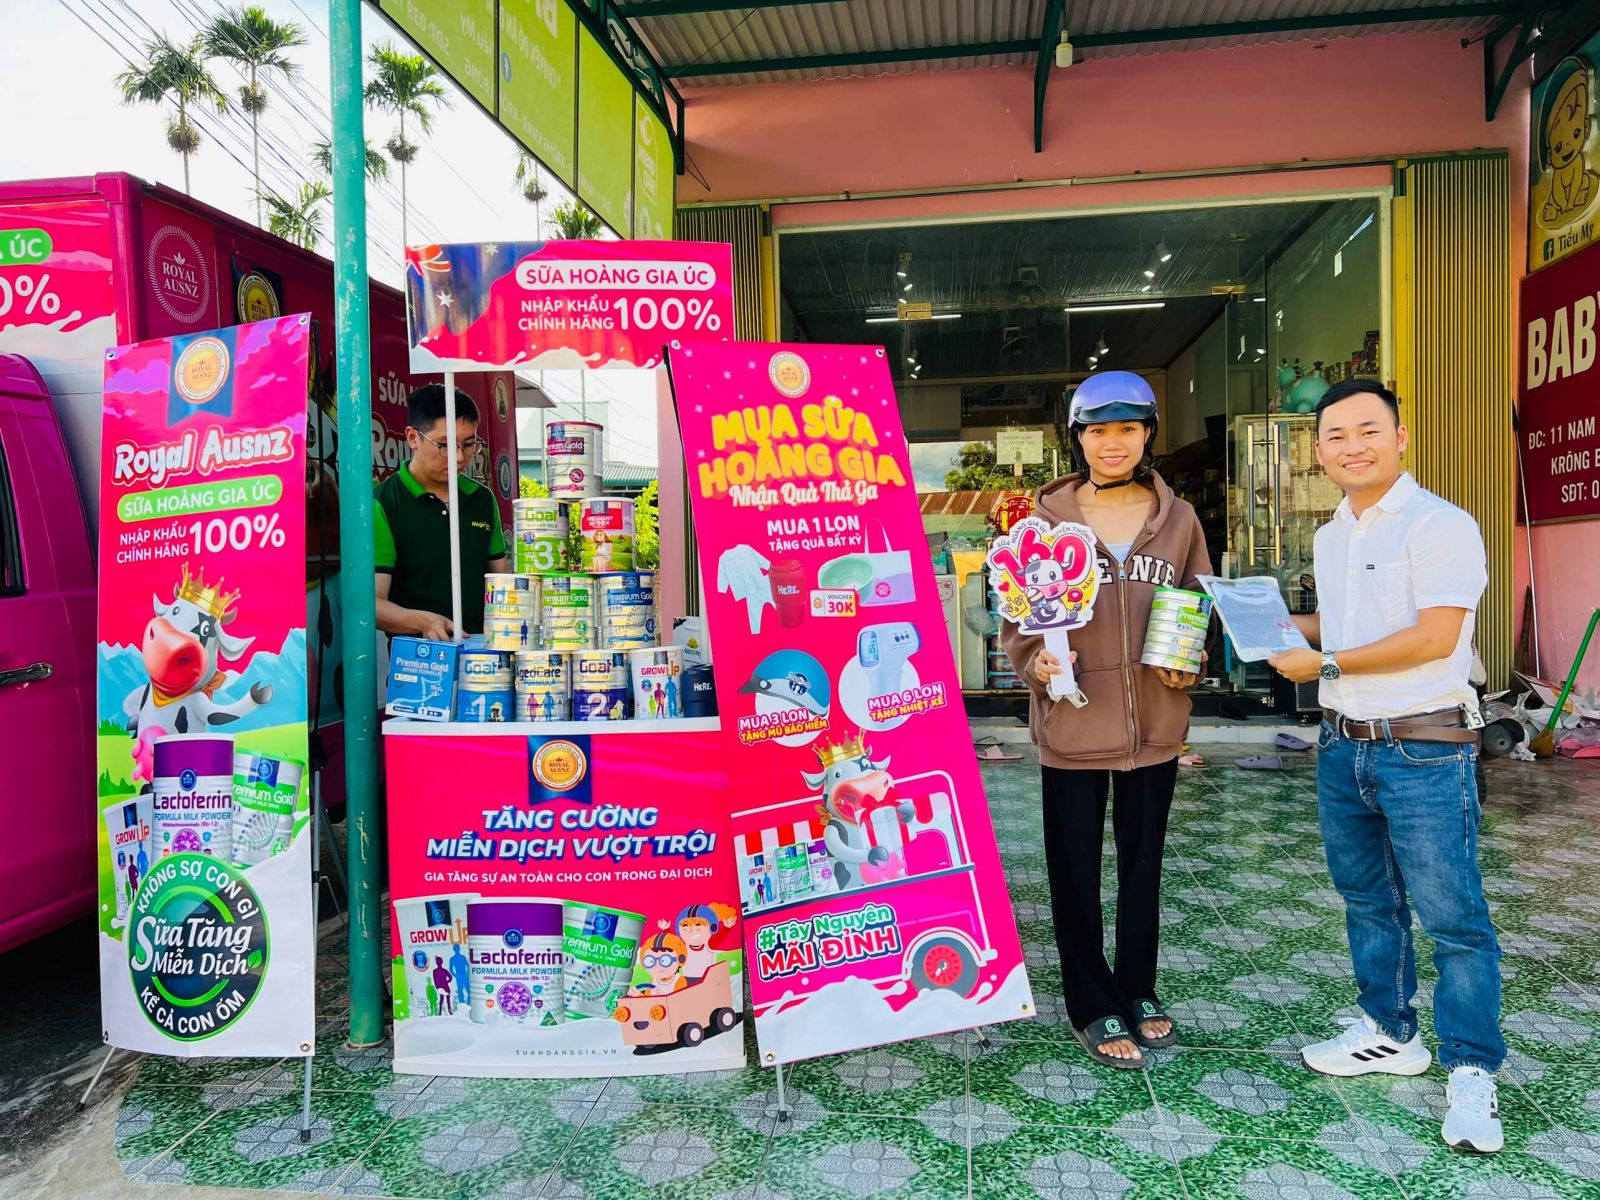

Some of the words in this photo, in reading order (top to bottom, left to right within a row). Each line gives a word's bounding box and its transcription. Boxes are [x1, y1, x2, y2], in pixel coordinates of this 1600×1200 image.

[10, 233, 42, 258] ÚC
[162, 261, 198, 284] ROYAL
[525, 264, 563, 284] SỮA
[569, 264, 640, 284] HOÀNG
[646, 269, 678, 284] GIA
[684, 266, 708, 285] ÚC
[163, 278, 199, 298] AUSNZ
[518, 315, 566, 331] CHÍNH
[569, 314, 614, 330] HÃNG
[613, 297, 721, 332] 100%
[521, 296, 563, 315] NHẬP
[567, 294, 609, 312] KHẨU
[1527, 291, 1600, 390] BAB
[711, 404, 799, 450] MUA
[801, 396, 879, 447] SỮA
[1528, 430, 1546, 450] ĐC:
[1550, 425, 1562, 445] 11
[1567, 416, 1596, 441] NAM
[114, 434, 193, 484] Royal
[200, 430, 288, 468] Ausnz
[565, 441, 583, 449] Gold
[699, 440, 833, 498] HOÀNG
[838, 446, 906, 486] GIA
[1551, 450, 1590, 476] KRÔNG
[124, 494, 153, 518] SỮA
[156, 490, 214, 513] HOÀNG
[218, 486, 248, 505] GIA
[252, 480, 275, 501] ÚC
[729, 484, 779, 511] Nhận
[781, 481, 819, 506] Quà
[820, 480, 853, 502] Thả
[854, 480, 878, 505] Ga
[1561, 482, 1587, 503] SĐT:
[116, 545, 151, 564] CHÍNH
[154, 542, 190, 559] HÃNG
[189, 512, 286, 555] 100%
[119, 527, 150, 547] NHẬP
[153, 521, 187, 542] KHẨU
[767, 518, 810, 536] MUA
[812, 517, 821, 534] 1
[825, 514, 860, 532] LON
[996, 537, 1011, 548] SỮA
[1010, 521, 1027, 544] HOÀNG
[1027, 519, 1040, 528] GIA
[1039, 523, 1048, 535] ÚC
[1048, 524, 1071, 543] TRUYỀN
[1072, 525, 1093, 543] THỐNG
[533, 541, 554, 570] 3
[768, 539, 800, 554] TẶNG
[801, 535, 825, 550] QUÀ
[827, 532, 847, 547] BẤT
[848, 533, 862, 546] KỲ
[991, 527, 1087, 588] 160
[1082, 575, 1095, 591] NĂM
[570, 593, 588, 602] Gold
[827, 601, 853, 613] 30K
[396, 657, 429, 669] Premium
[430, 661, 449, 672] Gold
[464, 660, 498, 675] Goat
[580, 659, 612, 674] Goat
[471, 694, 486, 722] 1
[587, 693, 608, 722] 2
[868, 693, 900, 710] MUA
[902, 691, 911, 702] 6
[913, 683, 944, 700] LON
[870, 708, 899, 723] TẶNG
[900, 700, 931, 716] NHIỆT
[931, 694, 945, 707] KẾ
[739, 713, 771, 731] MUA
[771, 712, 780, 726] 3
[781, 708, 809, 725] LON
[741, 730, 767, 744] TẶNG
[768, 725, 783, 737] MŨ
[784, 722, 804, 735] BẢO
[805, 716, 828, 730] HIỂM
[153, 789, 232, 810] Lactoferrin
[273, 787, 295, 806] Gold
[154, 812, 182, 821] FORMULA
[183, 812, 199, 821] MILK
[201, 811, 232, 820] POWDER
[481, 806, 554, 829] TĂNG
[560, 804, 658, 828] CƯỜNG
[426, 830, 492, 857] MIỄN
[498, 837, 564, 863] DỊCH
[572, 835, 651, 861] VƯỢT
[652, 829, 716, 856] TRỘI
[424, 871, 445, 882] GIA
[447, 869, 478, 883] TĂNG
[481, 870, 499, 886] SỰ
[500, 872, 517, 883] AN
[520, 870, 553, 883] TOÀN
[556, 872, 582, 883] CHO
[585, 871, 611, 882] CON
[614, 870, 656, 881] TRONG
[659, 869, 681, 881] ĐẠI
[683, 867, 713, 880] DỊCH
[137, 863, 177, 914] KHÔNG
[180, 860, 204, 880] SỢ
[205, 866, 242, 900] CON
[236, 898, 260, 920] GÌ
[759, 921, 812, 950] #Tây
[814, 905, 891, 933] Nguyên
[131, 916, 184, 971] Sữa
[187, 917, 253, 954] Tăng
[469, 948, 563, 965] Lactoferrin
[610, 944, 634, 959] Gold
[760, 939, 814, 978] MÃI
[819, 927, 897, 963] ĐỈNH
[152, 948, 194, 975] Miễn
[199, 951, 248, 979] Dịch
[471, 967, 508, 975] FORMULA
[509, 967, 528, 975] MILK
[530, 967, 562, 975] POWDER
[156, 1007, 174, 1031] CẢ
[178, 1011, 215, 1033] CON
[216, 989, 246, 1021] ỐM
[515, 1048, 618, 1056] SUAHOANGGIA.VN
